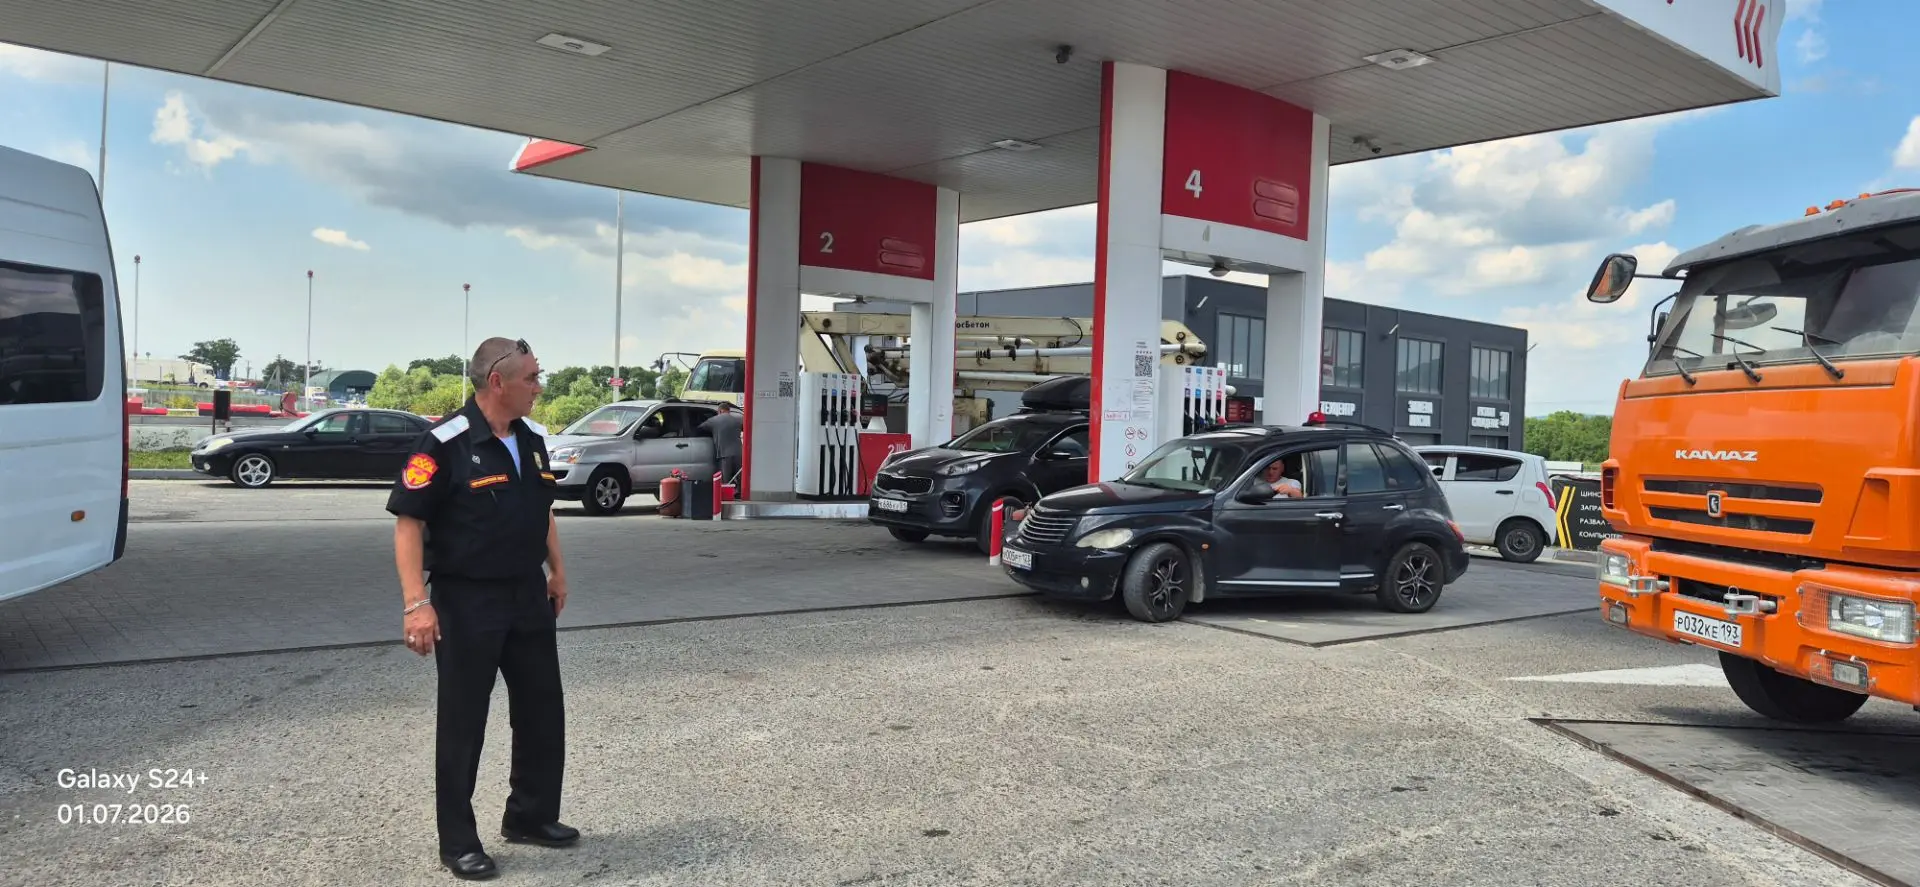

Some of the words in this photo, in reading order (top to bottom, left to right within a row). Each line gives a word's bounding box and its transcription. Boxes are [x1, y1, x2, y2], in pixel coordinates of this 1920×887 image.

[1185, 169, 1203, 199] 4
[820, 231, 833, 253] 2
[955, 320, 990, 329] осБетон
[1675, 449, 1758, 462] KAMAZ
[1677, 615, 1718, 639] Р032КЕ
[1721, 623, 1739, 640] 193
